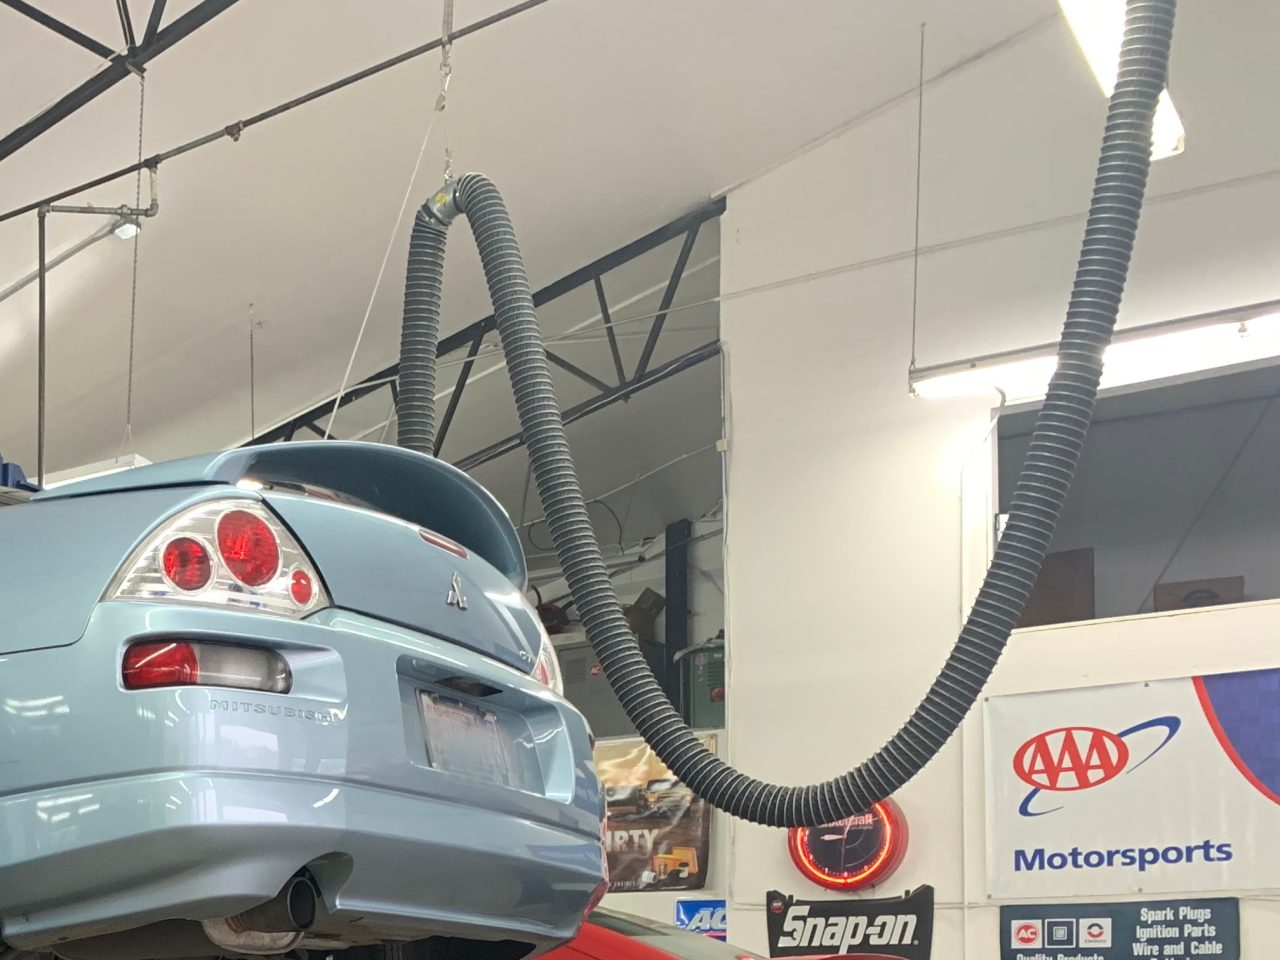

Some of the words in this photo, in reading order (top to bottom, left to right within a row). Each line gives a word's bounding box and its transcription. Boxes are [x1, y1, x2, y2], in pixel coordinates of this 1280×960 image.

[1020, 728, 1124, 790] AAA
[1013, 839, 1233, 872] Motorsports
[1140, 907, 1174, 924] Spark
[1179, 906, 1211, 923] Plugs
[777, 905, 917, 955] Snap-on
[1017, 928, 1037, 939] AC
[1136, 924, 1179, 941] Ignition
[1184, 923, 1216, 937] Parts
[1132, 942, 1159, 956] Wire
[1163, 941, 1185, 955] and
[1190, 940, 1223, 955] Cable
